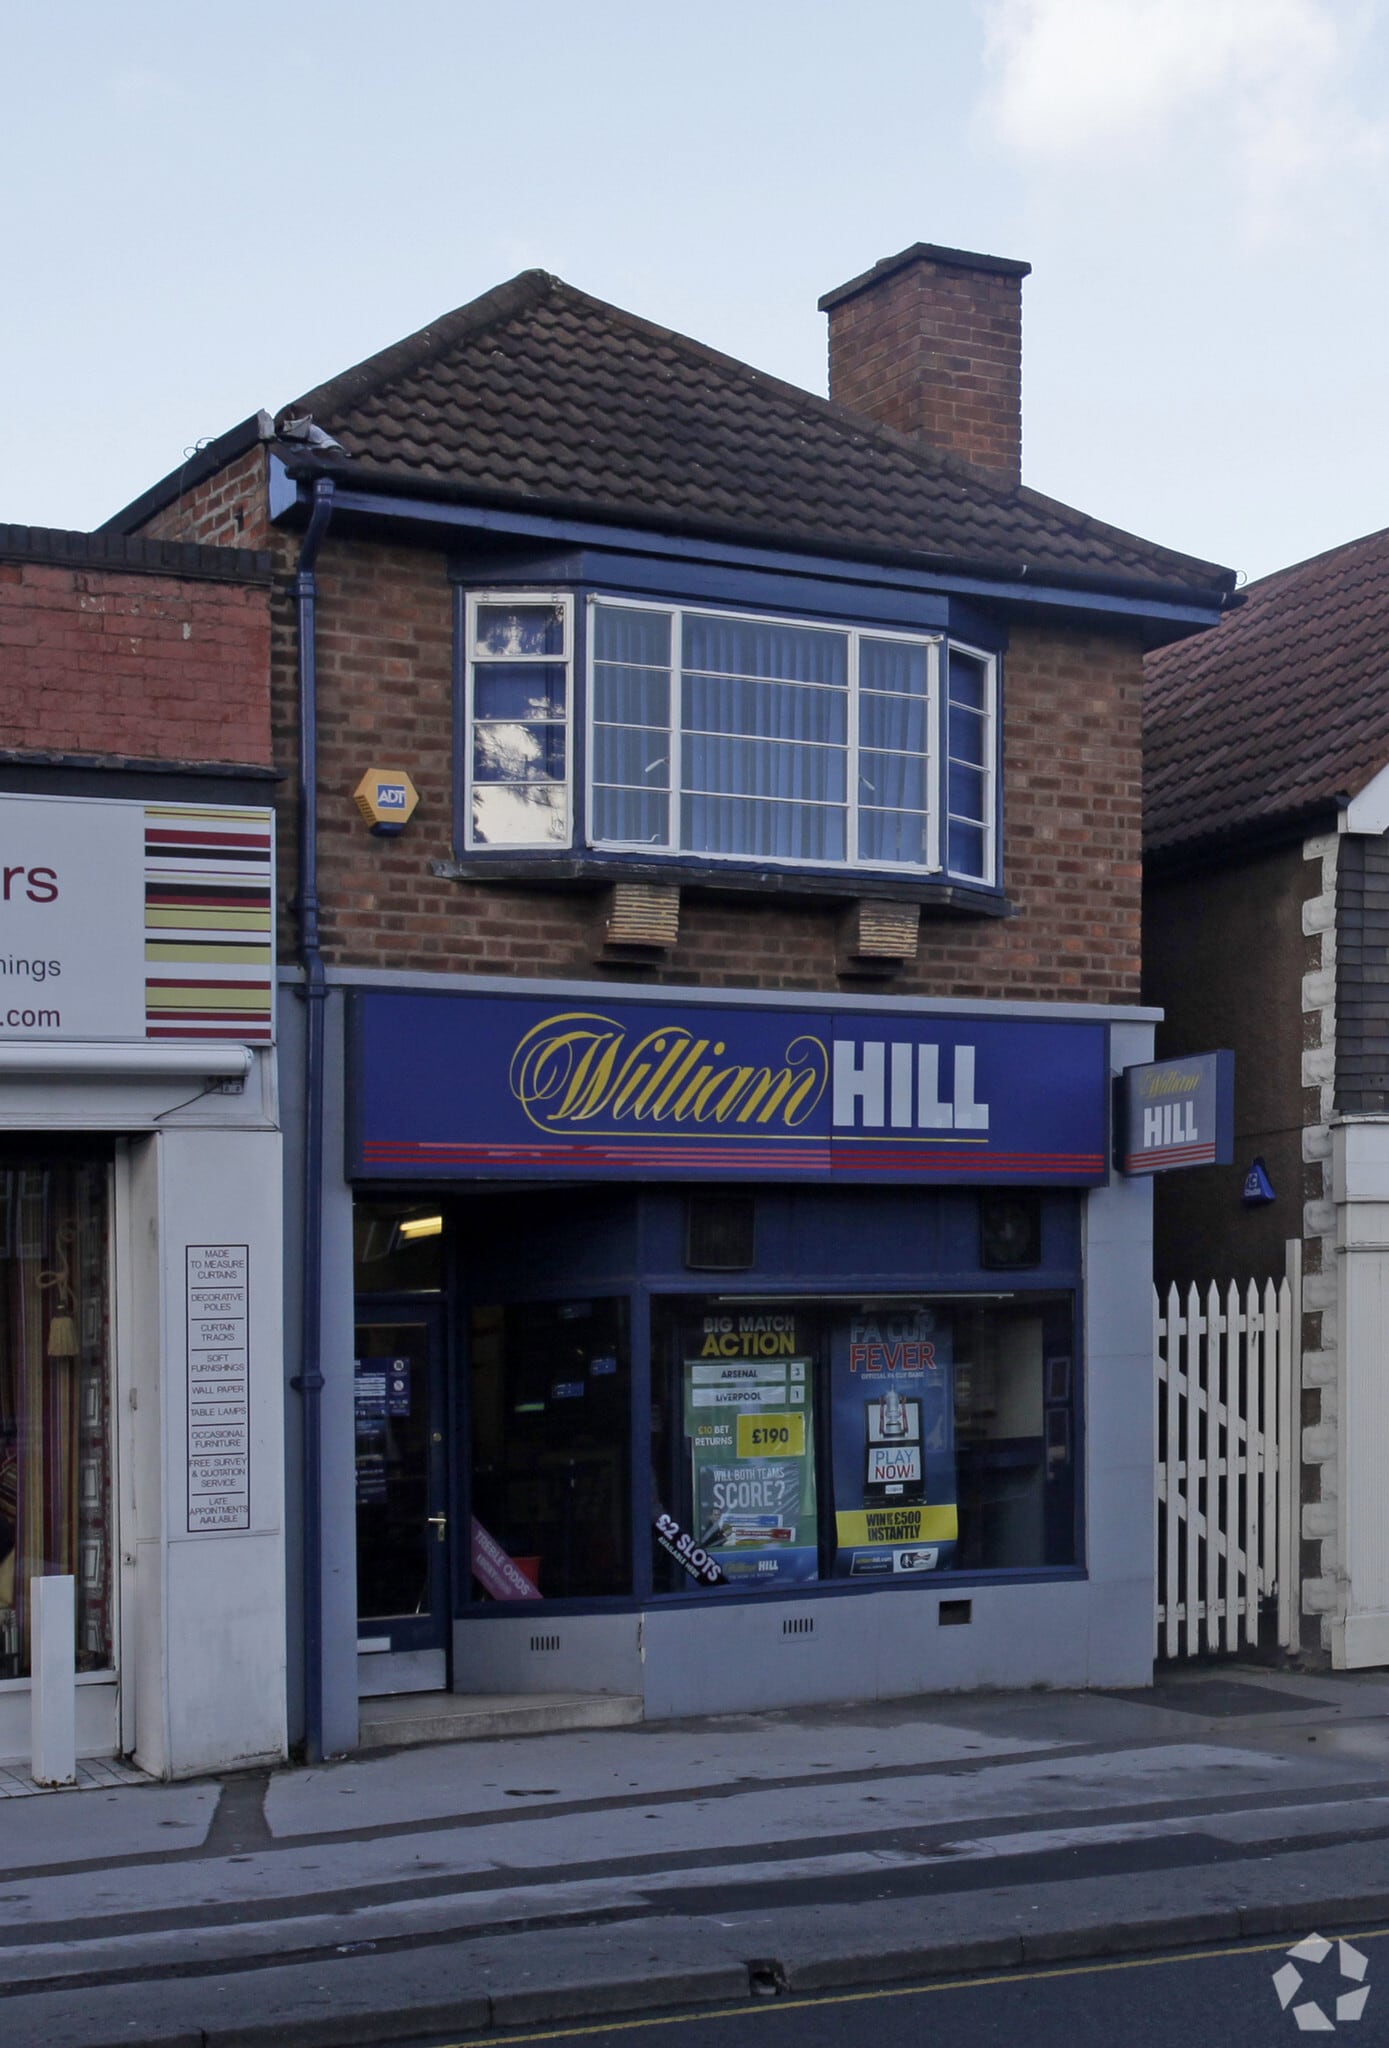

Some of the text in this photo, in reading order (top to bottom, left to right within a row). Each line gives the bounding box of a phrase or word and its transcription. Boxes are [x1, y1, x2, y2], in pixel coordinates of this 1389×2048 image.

[378, 789, 405, 804] ADT
[510, 1012, 989, 1135] William HILL
[1141, 1069, 1203, 1100] William
[1144, 1101, 1198, 1148] HILL
[205, 1250, 229, 1258] MADE
[205, 1260, 244, 1268] MEASURE
[198, 1271, 238, 1279] CURTAINS
[191, 1293, 243, 1302] DECORATIVE
[204, 1303, 231, 1311] POLES
[703, 1315, 796, 1333] BIG MATCH
[850, 1311, 936, 1343] FA CUP
[701, 1332, 796, 1356] ACTION
[207, 1354, 229, 1362] SOFT
[849, 1342, 937, 1373] FEVER
[192, 1364, 245, 1372] FURNISHINGS
[721, 1369, 758, 1379] ARSENAL
[192, 1386, 213, 1394] WALL
[716, 1391, 762, 1402] LIVERPOOL
[191, 1407, 247, 1416] TABLE LAMPS
[192, 1430, 245, 1439] OCCASIONAL
[714, 1425, 729, 1434] BET
[752, 1428, 789, 1444] £190
[195, 1439, 241, 1448] FURNITURE
[695, 1437, 733, 1446] RETURNS
[190, 1458, 247, 1467] FREE SURVEY
[875, 1450, 913, 1465] PLAY
[200, 1468, 246, 1477] QUOTATION
[713, 1466, 785, 1482] WILL BOTH TEAMS
[875, 1464, 914, 1479] NOW!
[201, 1479, 236, 1487] SERVICE
[713, 1480, 785, 1509] SCORE?
[190, 1505, 248, 1515] APPOINTMENTS
[200, 1515, 239, 1524] AVAILABLE
[866, 1513, 886, 1527] WIN
[895, 1511, 921, 1525] £500
[868, 1525, 921, 1542] INSTANTLY
[655, 1514, 722, 1582] £2 SLOTS
[758, 1560, 779, 1571] HILL
[503, 1564, 530, 1596] ODDS
